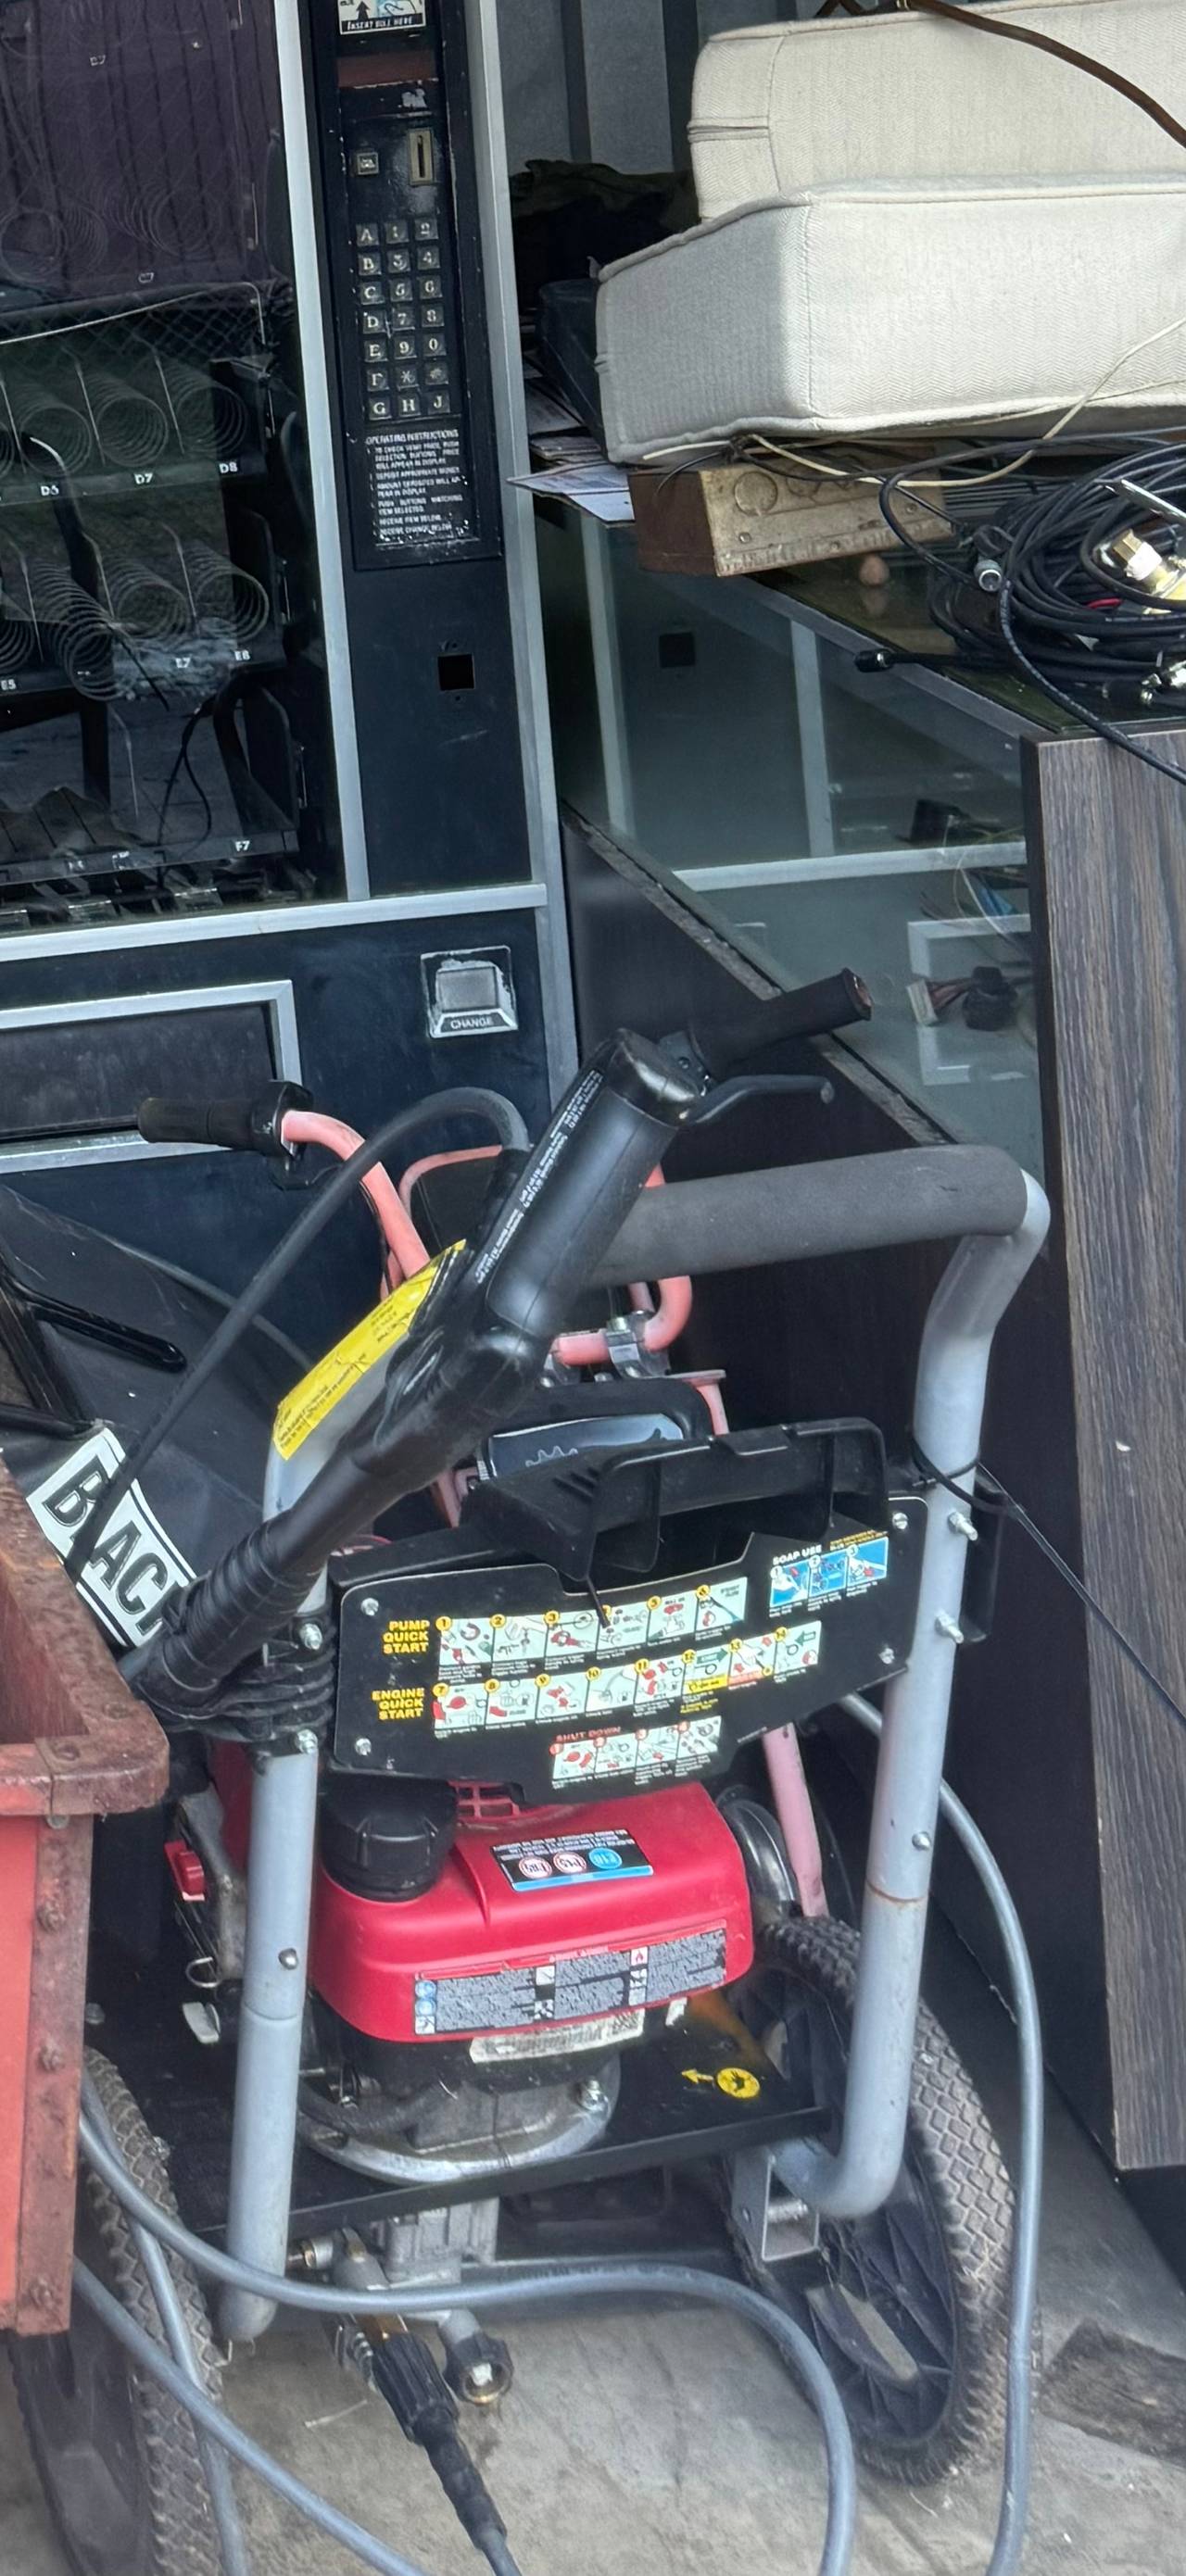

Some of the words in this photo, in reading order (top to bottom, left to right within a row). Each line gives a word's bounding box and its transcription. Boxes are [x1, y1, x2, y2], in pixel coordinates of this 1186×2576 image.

[347, 21, 373, 31] INSERT
[360, 230, 372, 241] A
[393, 255, 403, 268] 3
[423, 252, 432, 263] 4
[363, 258, 373, 270] B
[364, 286, 376, 299] C
[367, 316, 379, 328] D
[397, 313, 407, 325] 7
[369, 344, 381, 357] E
[399, 342, 410, 354] 9
[373, 402, 385, 414] G
[402, 399, 415, 412] H
[434, 396, 442, 408] J
[366, 434, 407, 445] OPERATING
[408, 429, 459, 441] INSTRUCTIONS
[219, 462, 238, 474] D8
[134, 473, 153, 485] D7
[40, 485, 59, 496] D6
[234, 840, 250, 852] F7
[773, 1550, 801, 1566] SOAP
[801, 1544, 823, 1558] USE
[389, 1620, 431, 1631] PUMP
[383, 1630, 430, 1643] QUICK
[383, 1641, 429, 1654] START
[372, 1688, 425, 1702] ENGINE
[379, 1699, 424, 1711] QUICK
[379, 1708, 423, 1721] START
[556, 1731, 586, 1742] SHUT
[588, 1726, 622, 1738] DOWN
